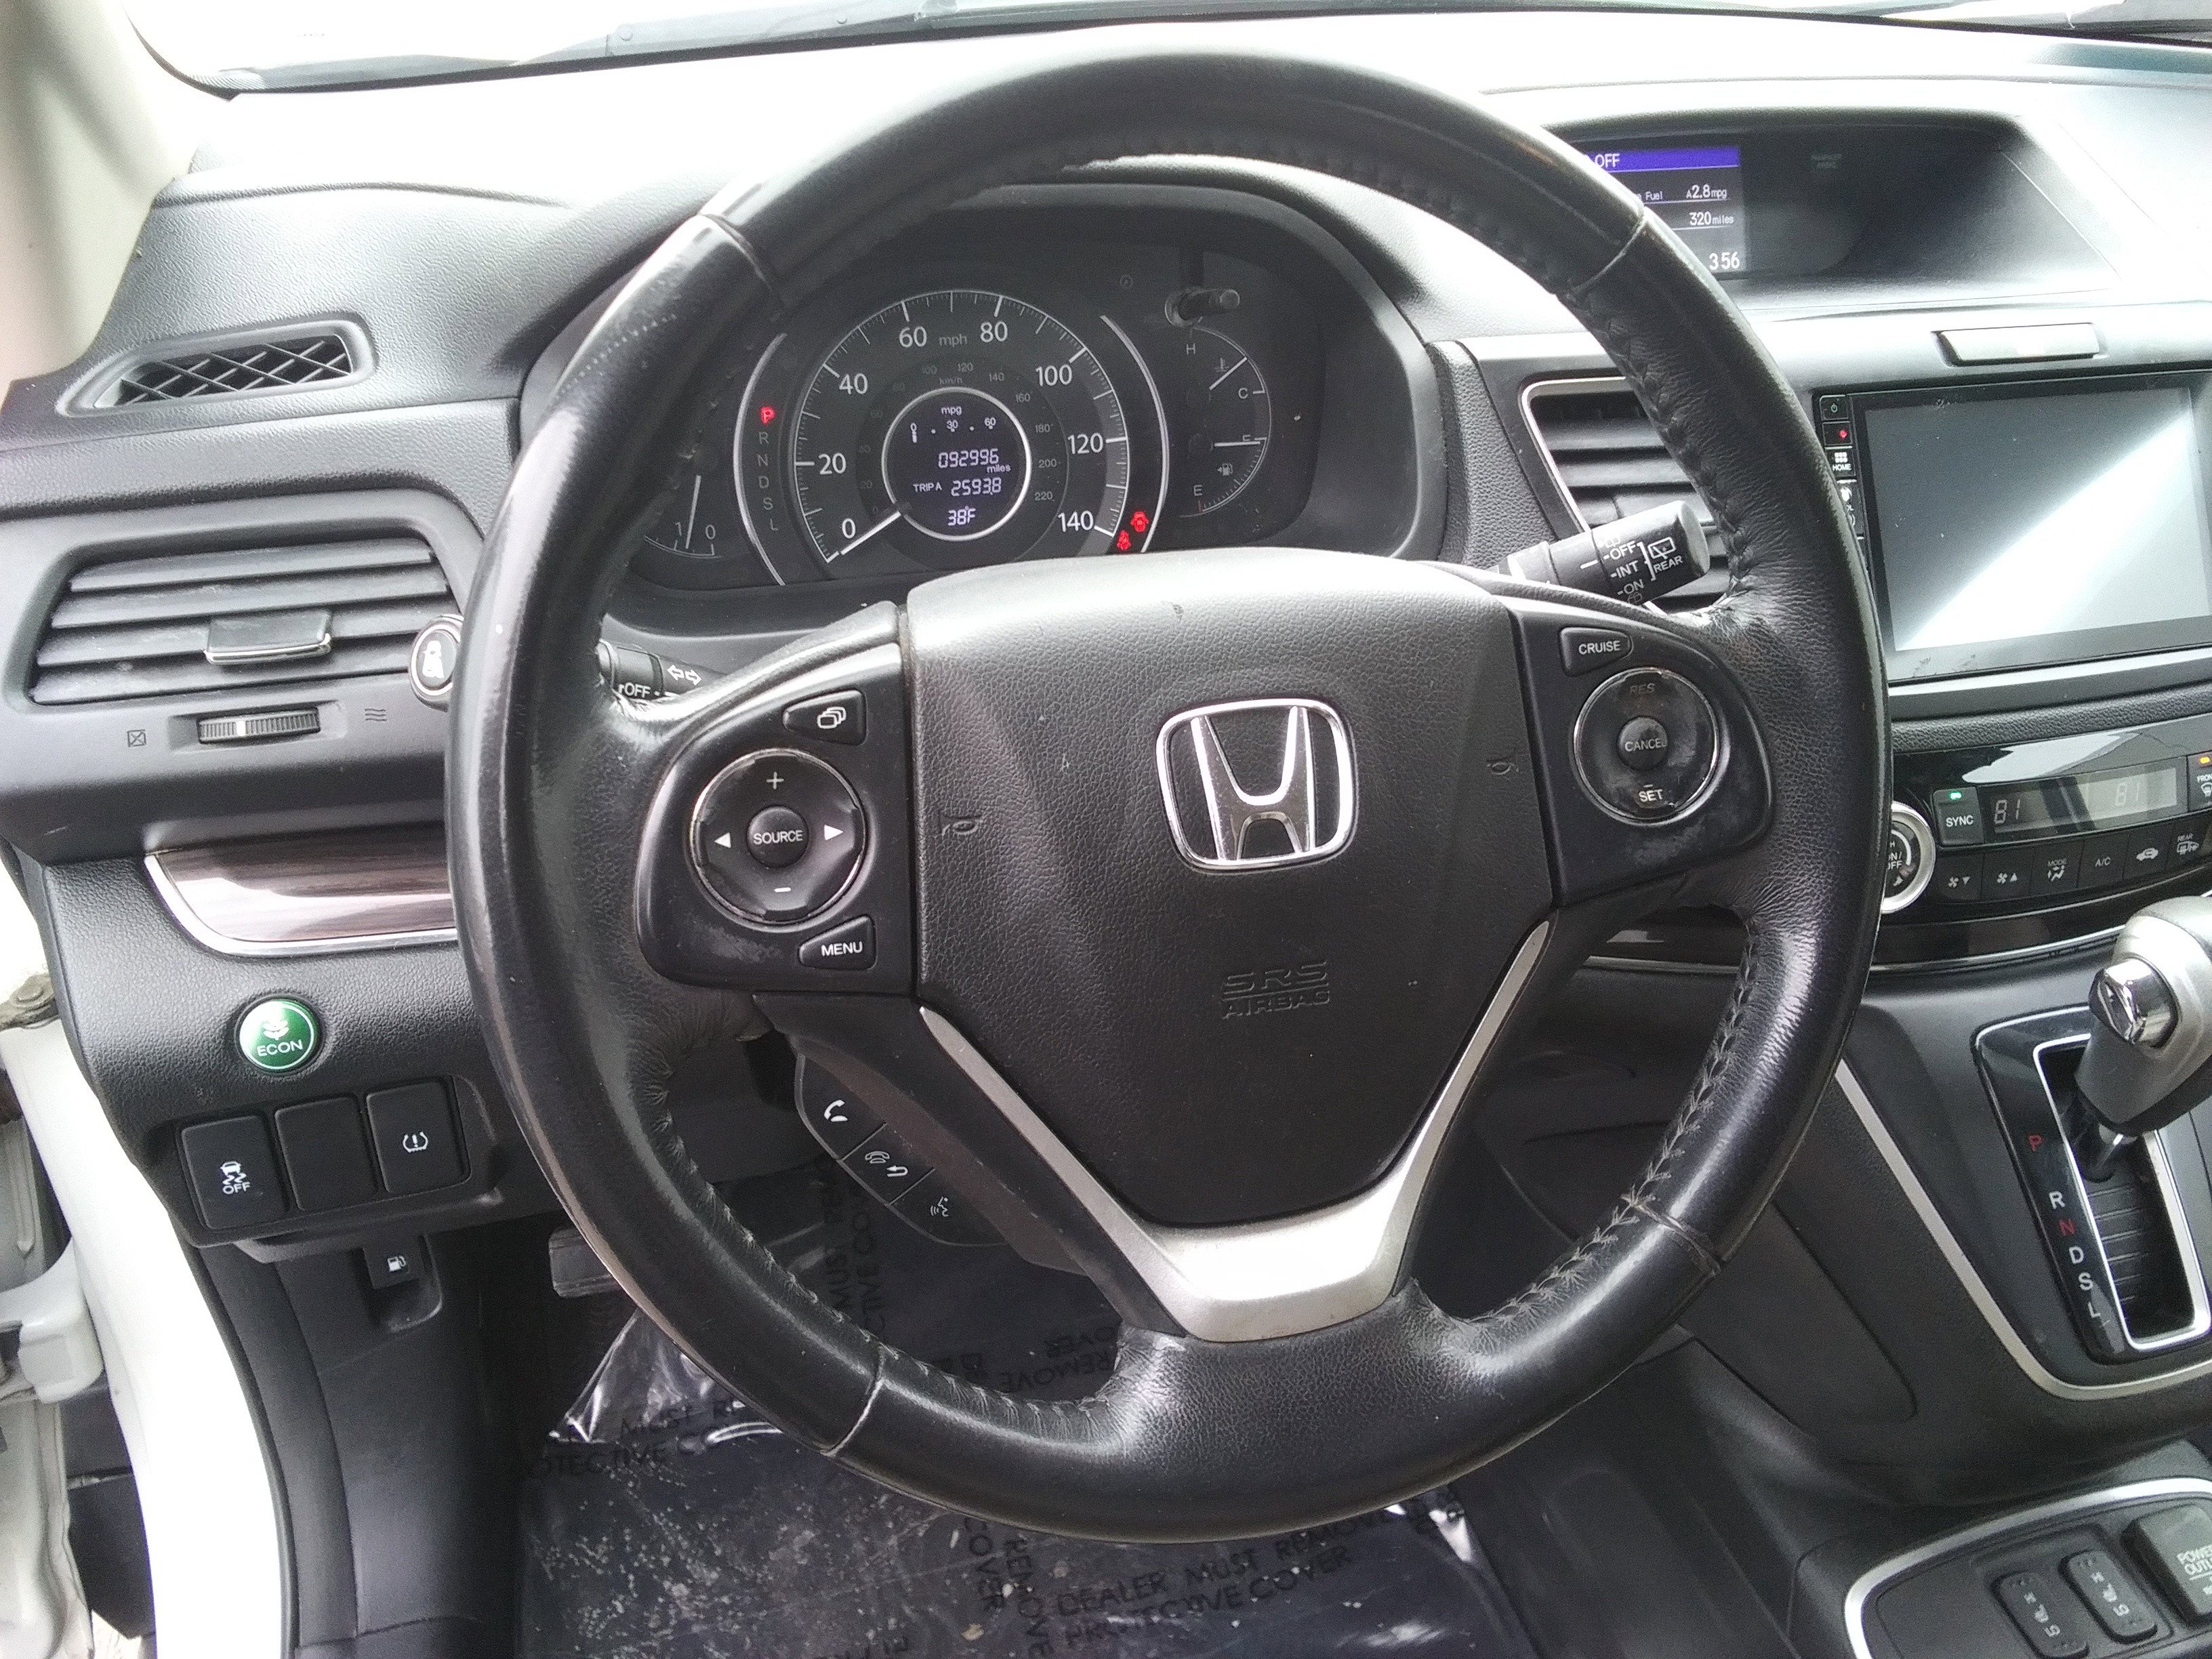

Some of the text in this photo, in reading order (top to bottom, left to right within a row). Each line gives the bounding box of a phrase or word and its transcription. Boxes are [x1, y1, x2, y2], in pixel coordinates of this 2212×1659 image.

[1645, 191, 1663, 201] Fuel
[899, 327, 927, 348] 60
[980, 321, 1008, 342] 80
[939, 333, 968, 347] mph
[1185, 344, 1196, 355] H
[957, 362, 974, 372] 120
[939, 376, 964, 386] km/h
[989, 372, 1005, 382] 140
[1036, 364, 1072, 387] 100
[838, 373, 868, 395] 40
[1017, 392, 1031, 403] 160
[1237, 388, 1248, 399] C
[760, 407, 776, 424] P
[941, 406, 962, 416] mpg
[983, 416, 997, 427] 60
[1034, 424, 1050, 434] 180
[758, 431, 769, 445] R
[1068, 432, 1104, 455] 120
[757, 453, 769, 467] N
[819, 453, 847, 476] 20
[938, 447, 1000, 469] 092996
[1038, 458, 1057, 468] 200
[987, 464, 1011, 474] miles
[1832, 462, 1852, 472] HOME
[758, 476, 769, 489] D
[1034, 491, 1053, 501] 220
[1193, 485, 1203, 497] E
[763, 497, 774, 510] S
[841, 517, 856, 539] 0
[1059, 511, 1094, 533] 140
[1610, 540, 1637, 560] OFF
[1615, 560, 1639, 579] INT
[1653, 554, 1684, 574] REAR
[1623, 578, 1645, 595] ON
[1578, 640, 1620, 655] CRUISE
[624, 682, 651, 698] OFF
[1624, 737, 1667, 752] CANCEL
[1639, 788, 1664, 802] SET
[1994, 799, 2021, 825] 81
[1946, 815, 1974, 828] SYNC
[752, 830, 804, 846] SOURCE
[2094, 855, 2112, 868] A/C
[821, 941, 863, 957] MENU
[1223, 960, 1328, 996] SRS
[1221, 990, 1330, 1021] AIRBAG
[257, 1040, 304, 1057] ECON
[2029, 1135, 2044, 1151] P
[222, 1181, 251, 1195] OFF
[2049, 1191, 2066, 1208] R
[2060, 1220, 2076, 1235] N
[2069, 1246, 2085, 1265] D
[2078, 1273, 2093, 1290] S
[2088, 1301, 2101, 1318] L
